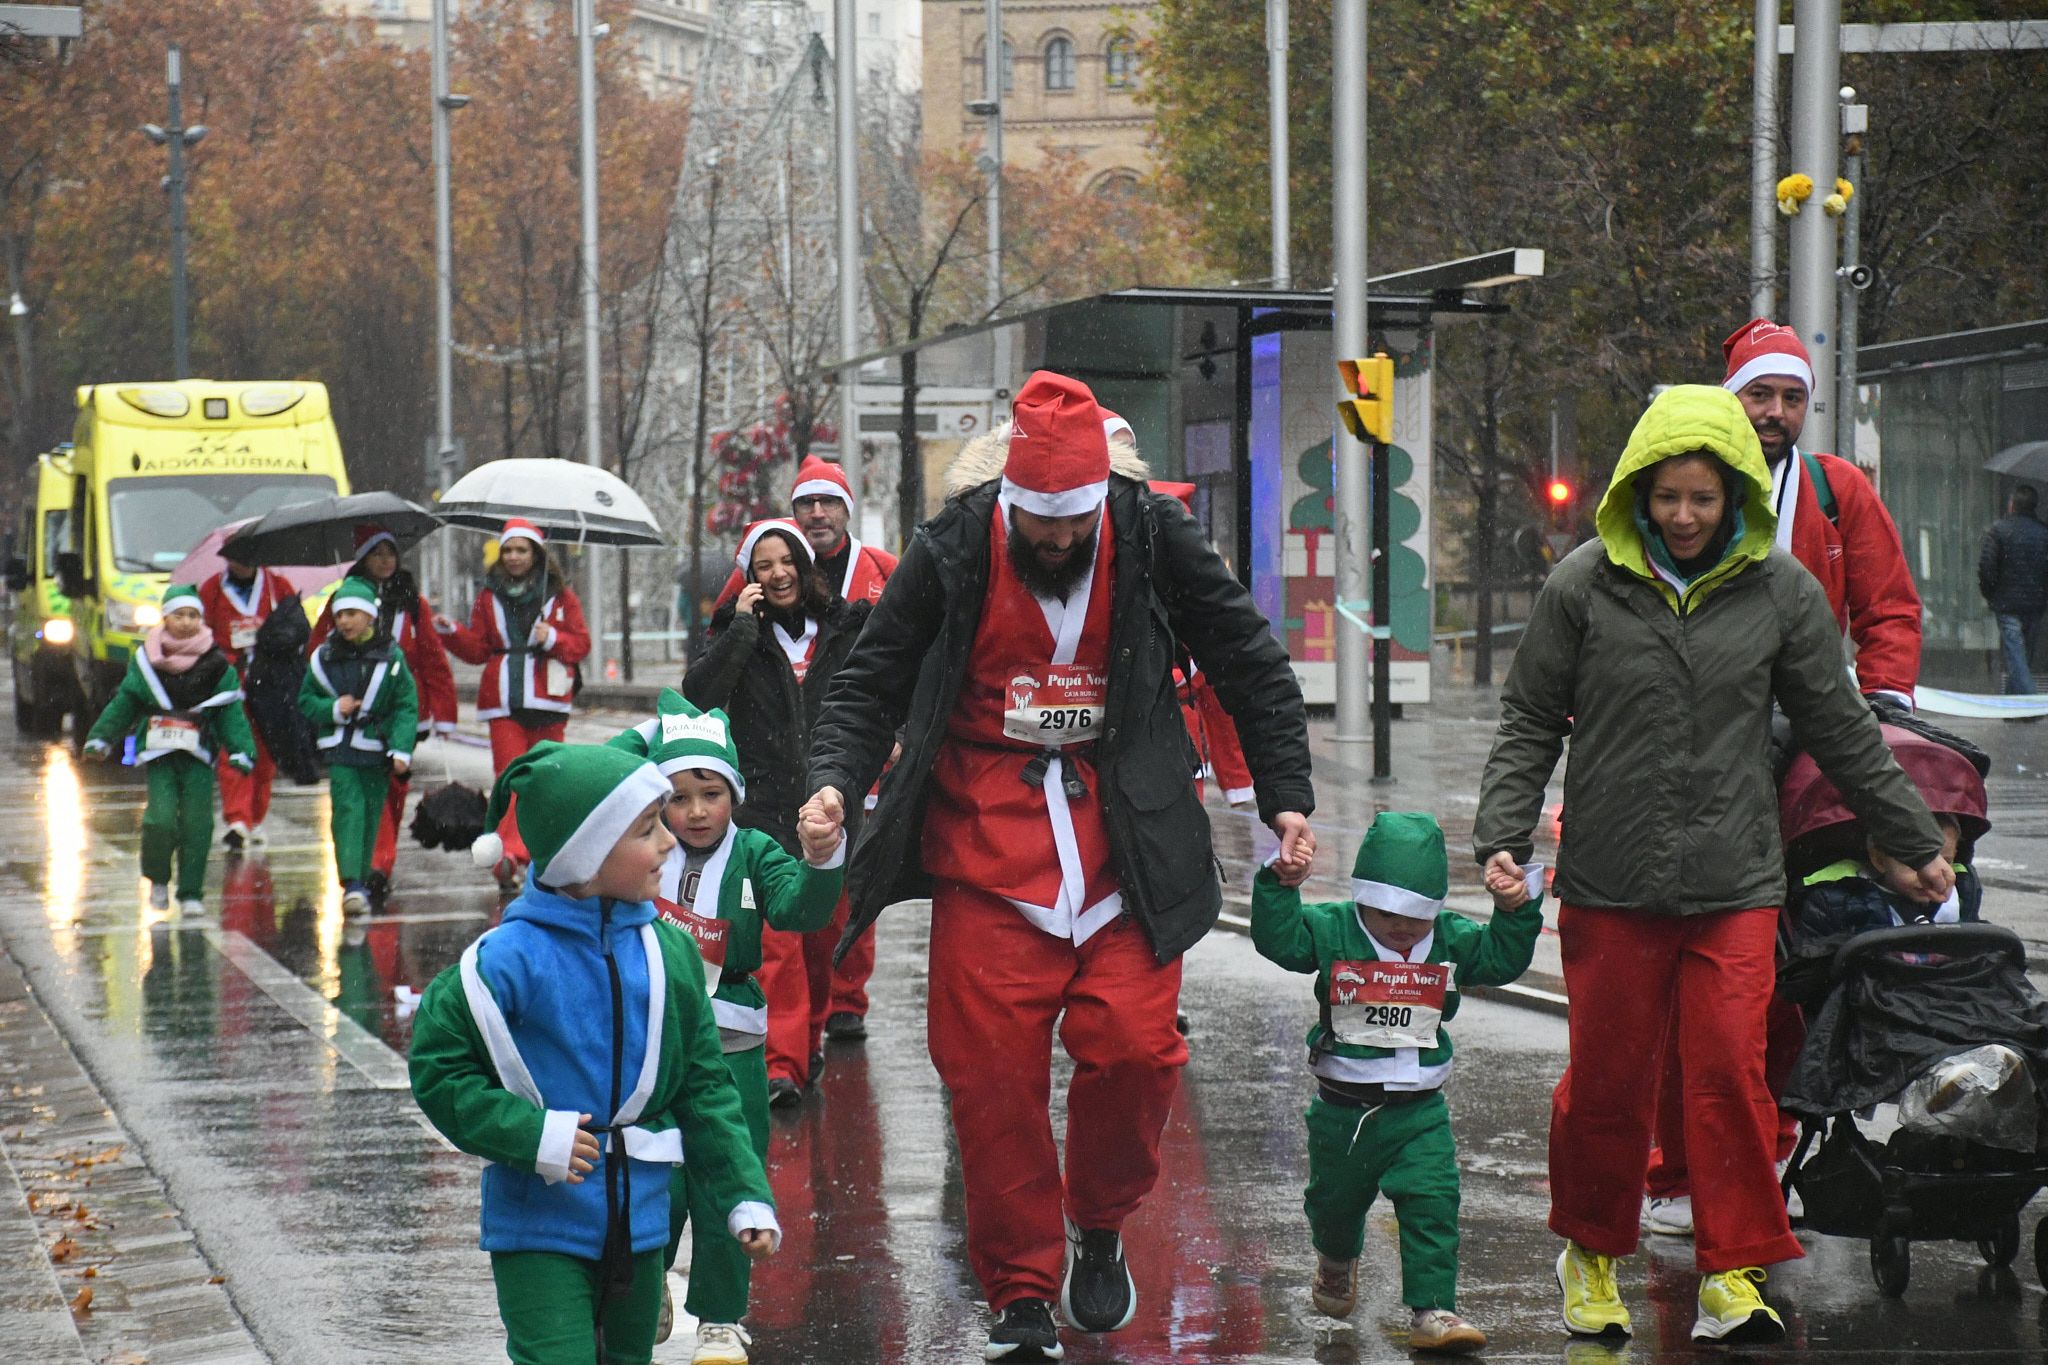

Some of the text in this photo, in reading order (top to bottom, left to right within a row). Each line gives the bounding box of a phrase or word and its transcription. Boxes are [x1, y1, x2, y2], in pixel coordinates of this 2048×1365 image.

[1047, 673, 1108, 689] Papá Noe
[1039, 709, 1091, 729] 2976
[666, 723, 690, 735] CAJA
[695, 925, 723, 942] Noel
[1372, 971, 1408, 986] Papá
[1411, 971, 1441, 986] Noel
[1365, 1006, 1412, 1028] 2980
